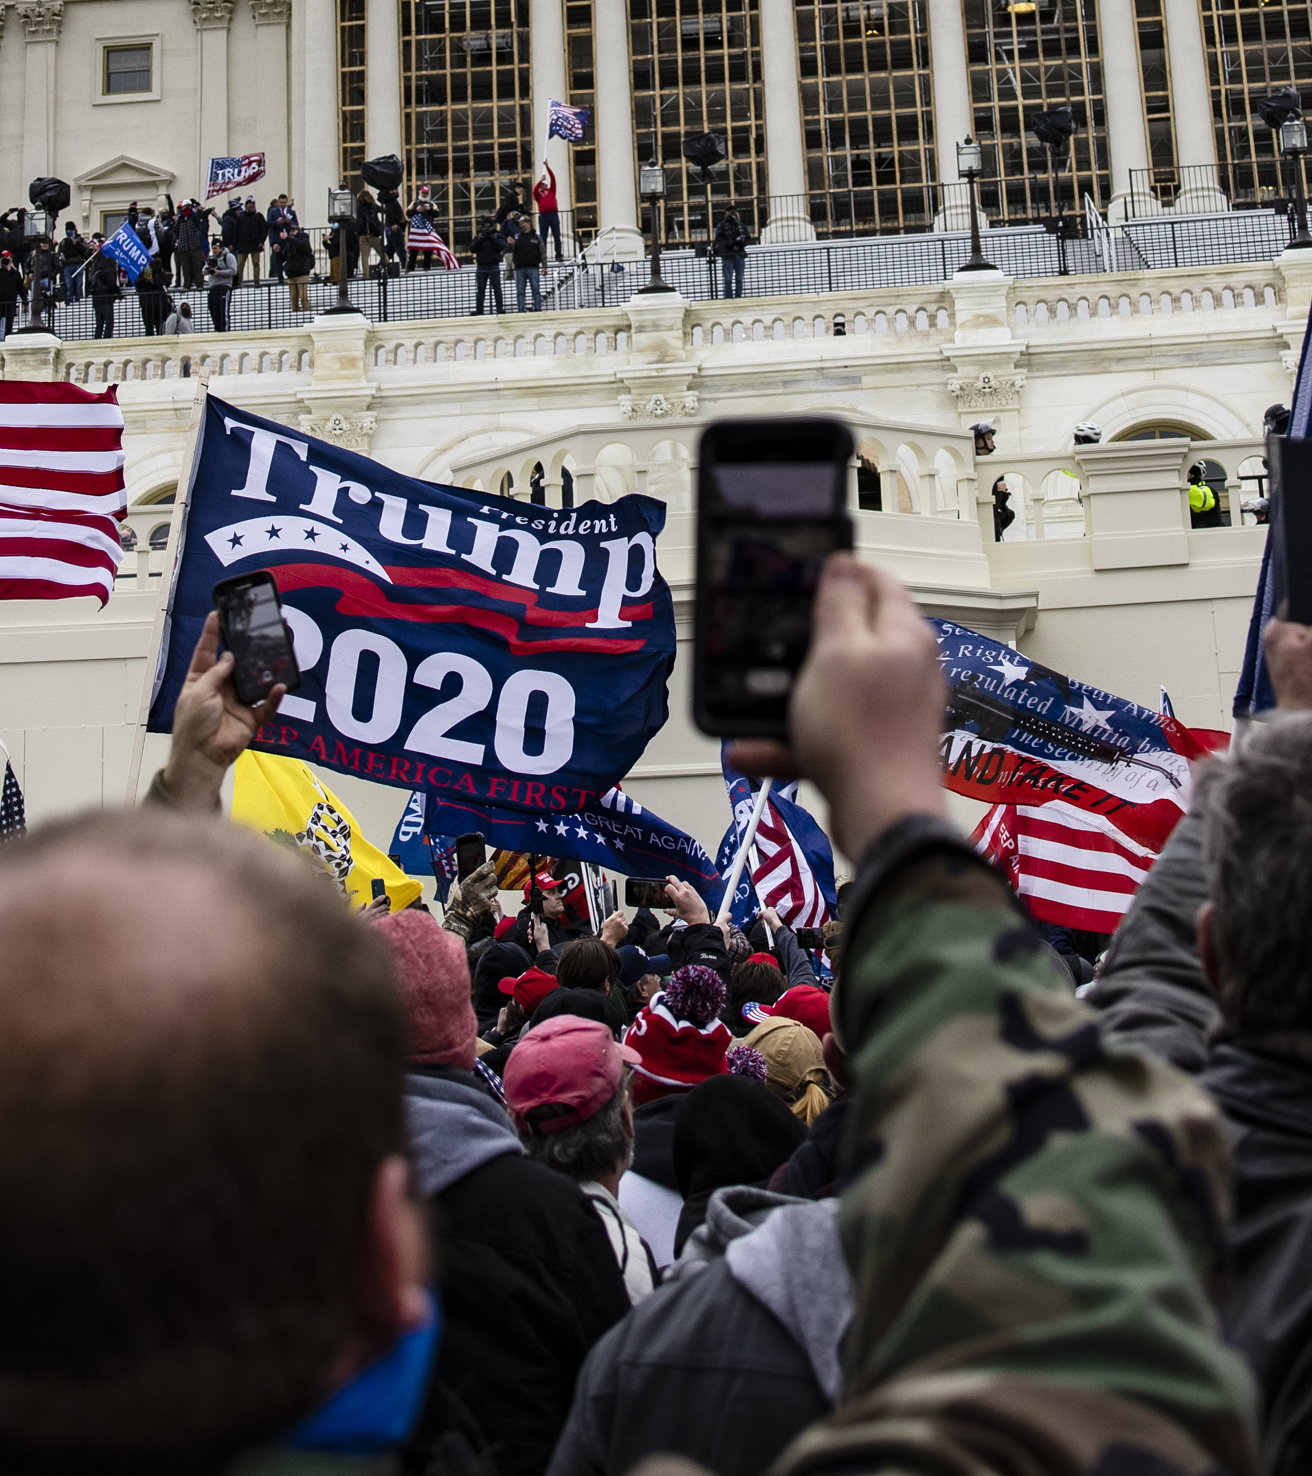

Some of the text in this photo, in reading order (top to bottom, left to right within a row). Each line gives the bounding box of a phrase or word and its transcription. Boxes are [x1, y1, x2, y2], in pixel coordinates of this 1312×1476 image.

[224, 417, 656, 629] Trump
[957, 644, 1023, 666] Right
[253, 722, 299, 746] EP
[307, 734, 479, 795] AMERICA
[1136, 736, 1190, 777] being
[1007, 755, 1090, 801] TAKE
[1089, 792, 1138, 816] IT
[1124, 766, 1152, 790] of
[584, 812, 644, 841] GREAT
